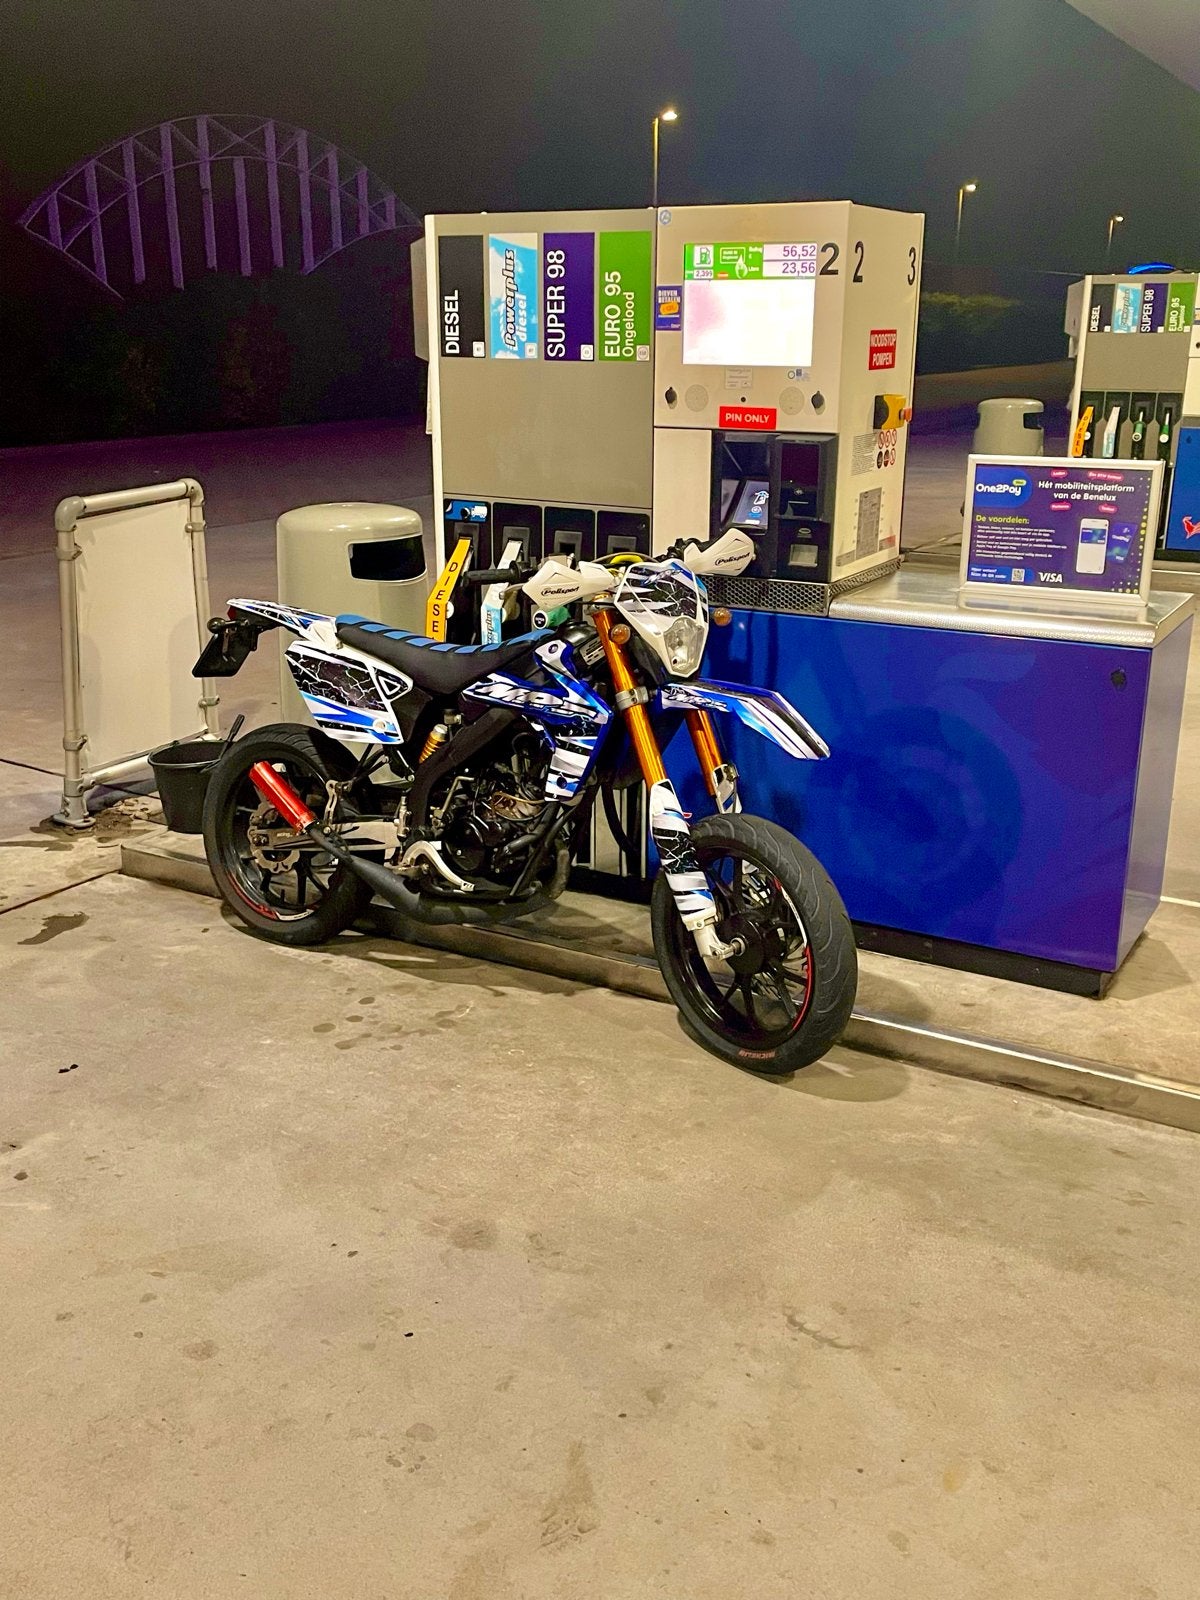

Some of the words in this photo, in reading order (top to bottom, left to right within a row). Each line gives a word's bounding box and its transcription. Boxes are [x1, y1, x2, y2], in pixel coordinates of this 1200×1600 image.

[782, 245, 816, 260] 56,52
[819, 243, 840, 276] 2
[547, 249, 566, 279] 98
[782, 262, 816, 277] 23,56
[853, 241, 865, 283] 2
[907, 247, 917, 286] 3
[605, 271, 622, 297] 95
[503, 249, 517, 348] Powerplus
[1144, 289, 1155, 301] 98
[1171, 297, 1180, 308] 95
[445, 289, 460, 355] DIESEL
[515, 294, 527, 342] diesel
[546, 286, 566, 359] SUPER
[622, 291, 637, 358] Ongelood
[1090, 305, 1101, 332] DIESEL
[1141, 302, 1154, 332] SUPER
[1168, 310, 1178, 332] EURO
[605, 304, 621, 358] EURO
[870, 333, 897, 348] NOODSTOP
[872, 352, 893, 367] POMPEN
[725, 412, 742, 423] PIN
[744, 413, 770, 424] ONLY
[976, 483, 1021, 497] One2Pay
[1038, 480, 1053, 489] Hét
[1054, 482, 1135, 493] mobiliteitsplatform
[1071, 492, 1081, 500] de
[1083, 493, 1117, 502] Benelux
[975, 514, 987, 523] De
[988, 515, 1030, 525] voordelen:
[715, 552, 751, 567] Polisport
[1038, 572, 1063, 583] VISA
[540, 585, 581, 598] Polisport
